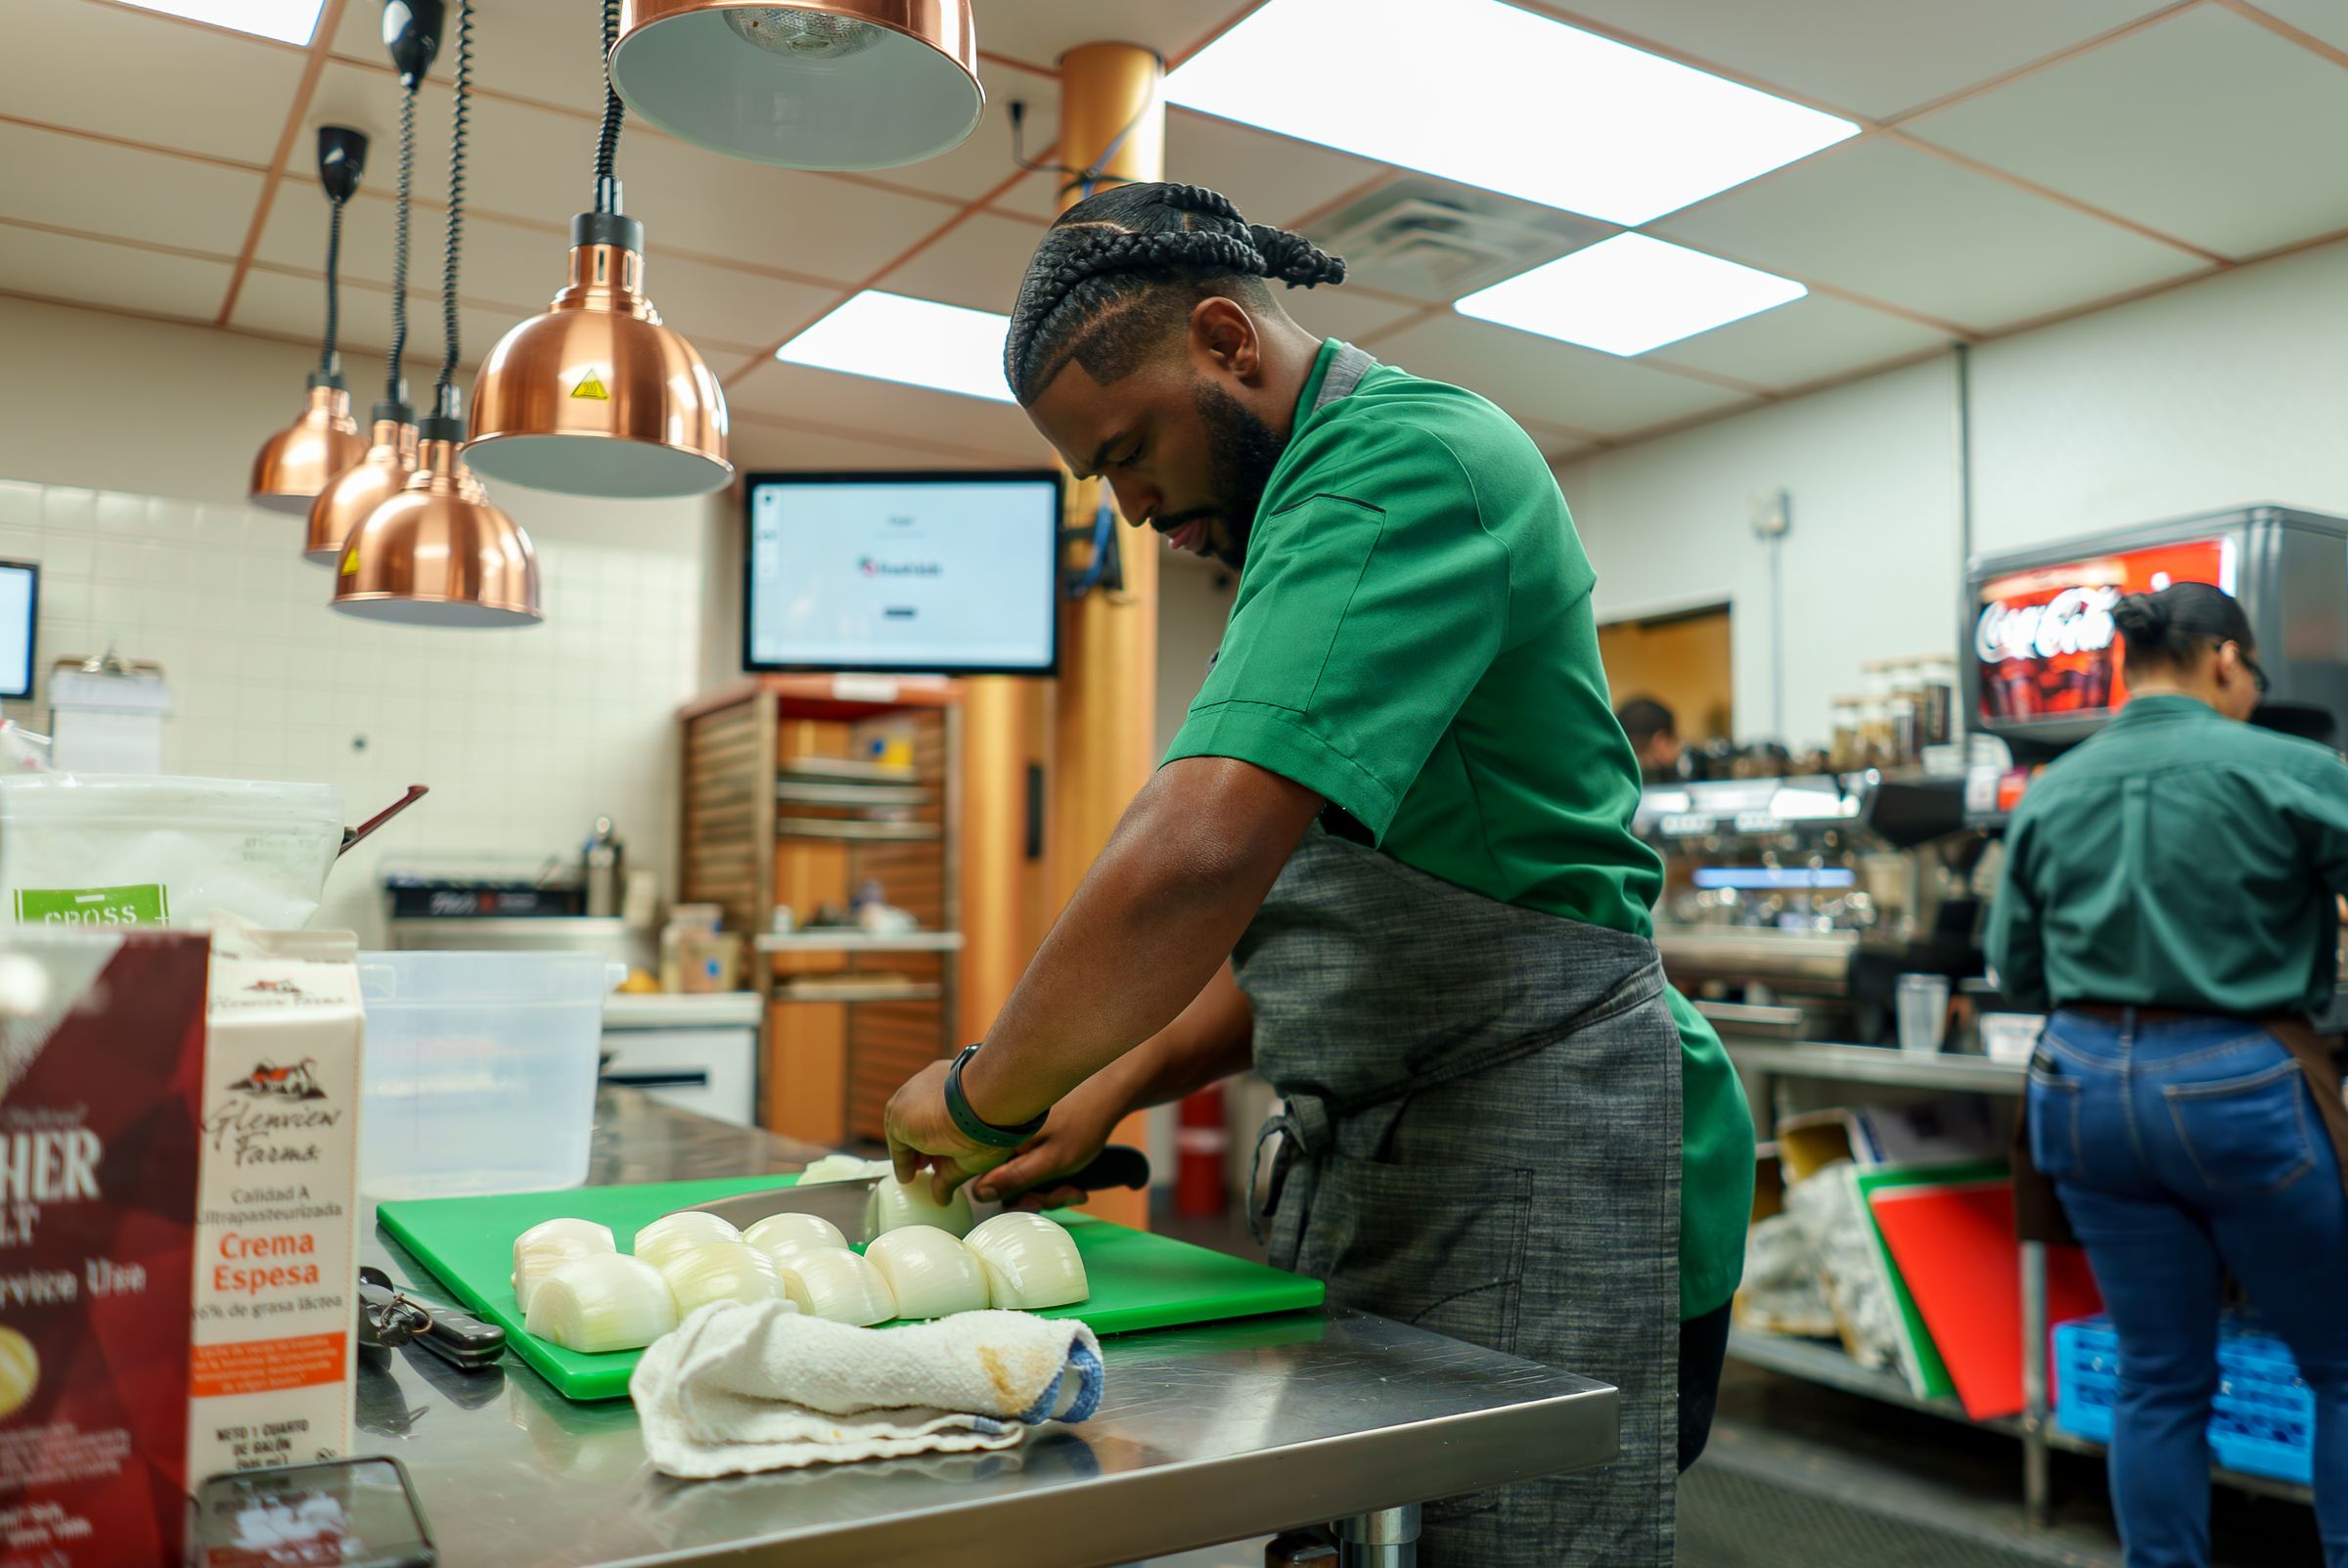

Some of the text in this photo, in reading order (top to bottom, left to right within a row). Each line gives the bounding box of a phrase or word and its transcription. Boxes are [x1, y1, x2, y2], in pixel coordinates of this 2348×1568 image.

[235, 1131, 323, 1166] Farms
[231, 1184, 311, 1204] Calidad A
[219, 1232, 315, 1260] Crema
[85, 1257, 147, 1297] Use
[212, 1263, 320, 1296] Espesa
[250, 1300, 294, 1319] grasa
[261, 1418, 310, 1438] CUARTO
